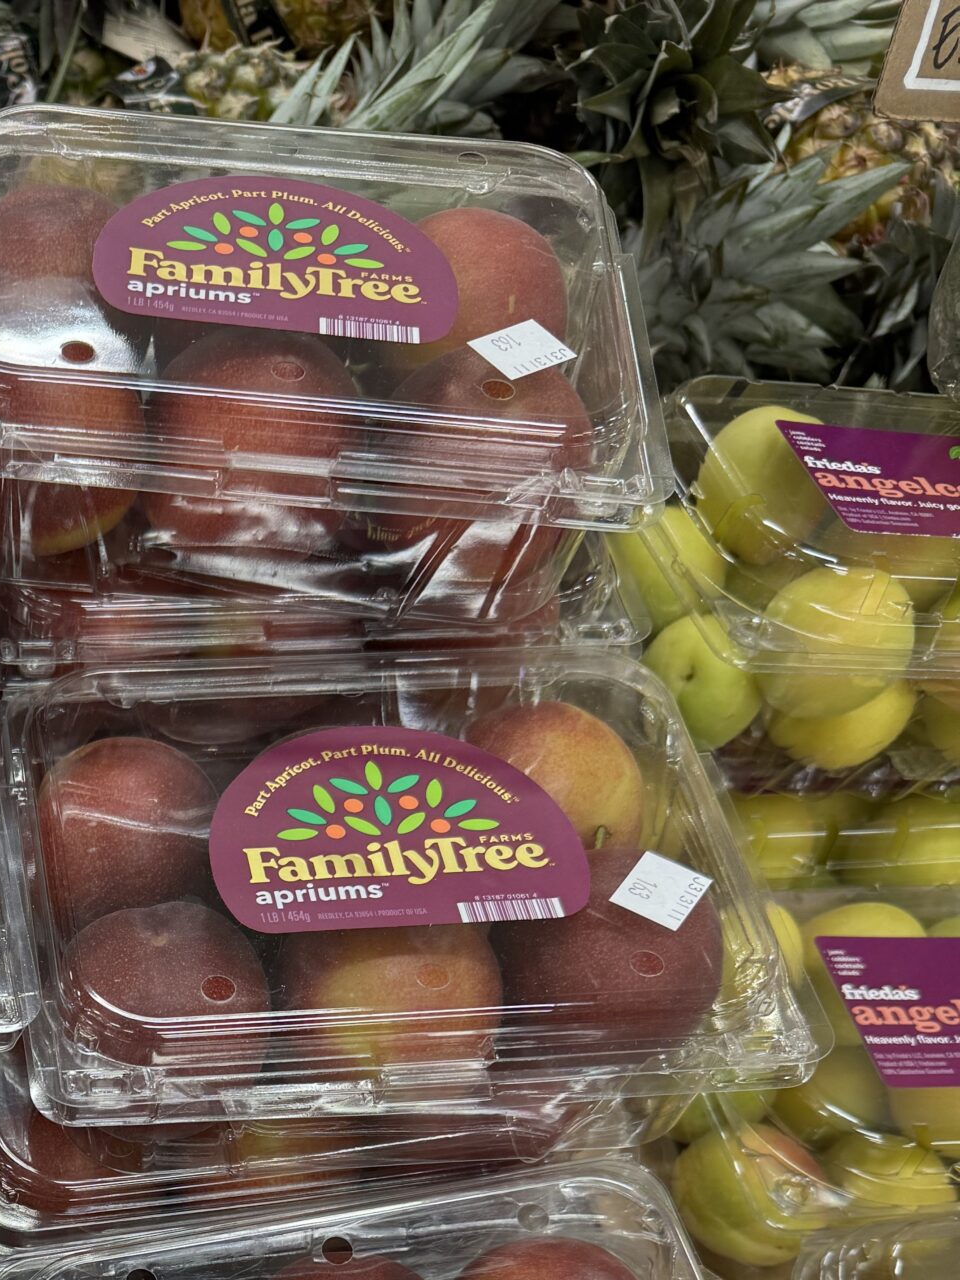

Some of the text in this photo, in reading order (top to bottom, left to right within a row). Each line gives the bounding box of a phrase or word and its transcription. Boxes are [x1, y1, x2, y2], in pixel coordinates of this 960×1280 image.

[142, 189, 407, 253] Part Apricot. Part Plum. All Delicious.
[127, 247, 421, 304] FamilyTree
[361, 272, 413, 282] FARMS
[128, 281, 252, 304] apriums
[491, 334, 521, 352] 163
[828, 493, 879, 505] Heavenly
[245, 745, 512, 817] Part Apricot. Part Plum. All Delicious.
[479, 833, 533, 843] FARMS
[243, 837, 548, 884] FamilyTree
[255, 883, 383, 908] apriums
[628, 878, 658, 900] 163
[864, 1035, 916, 1046] Heavenly
